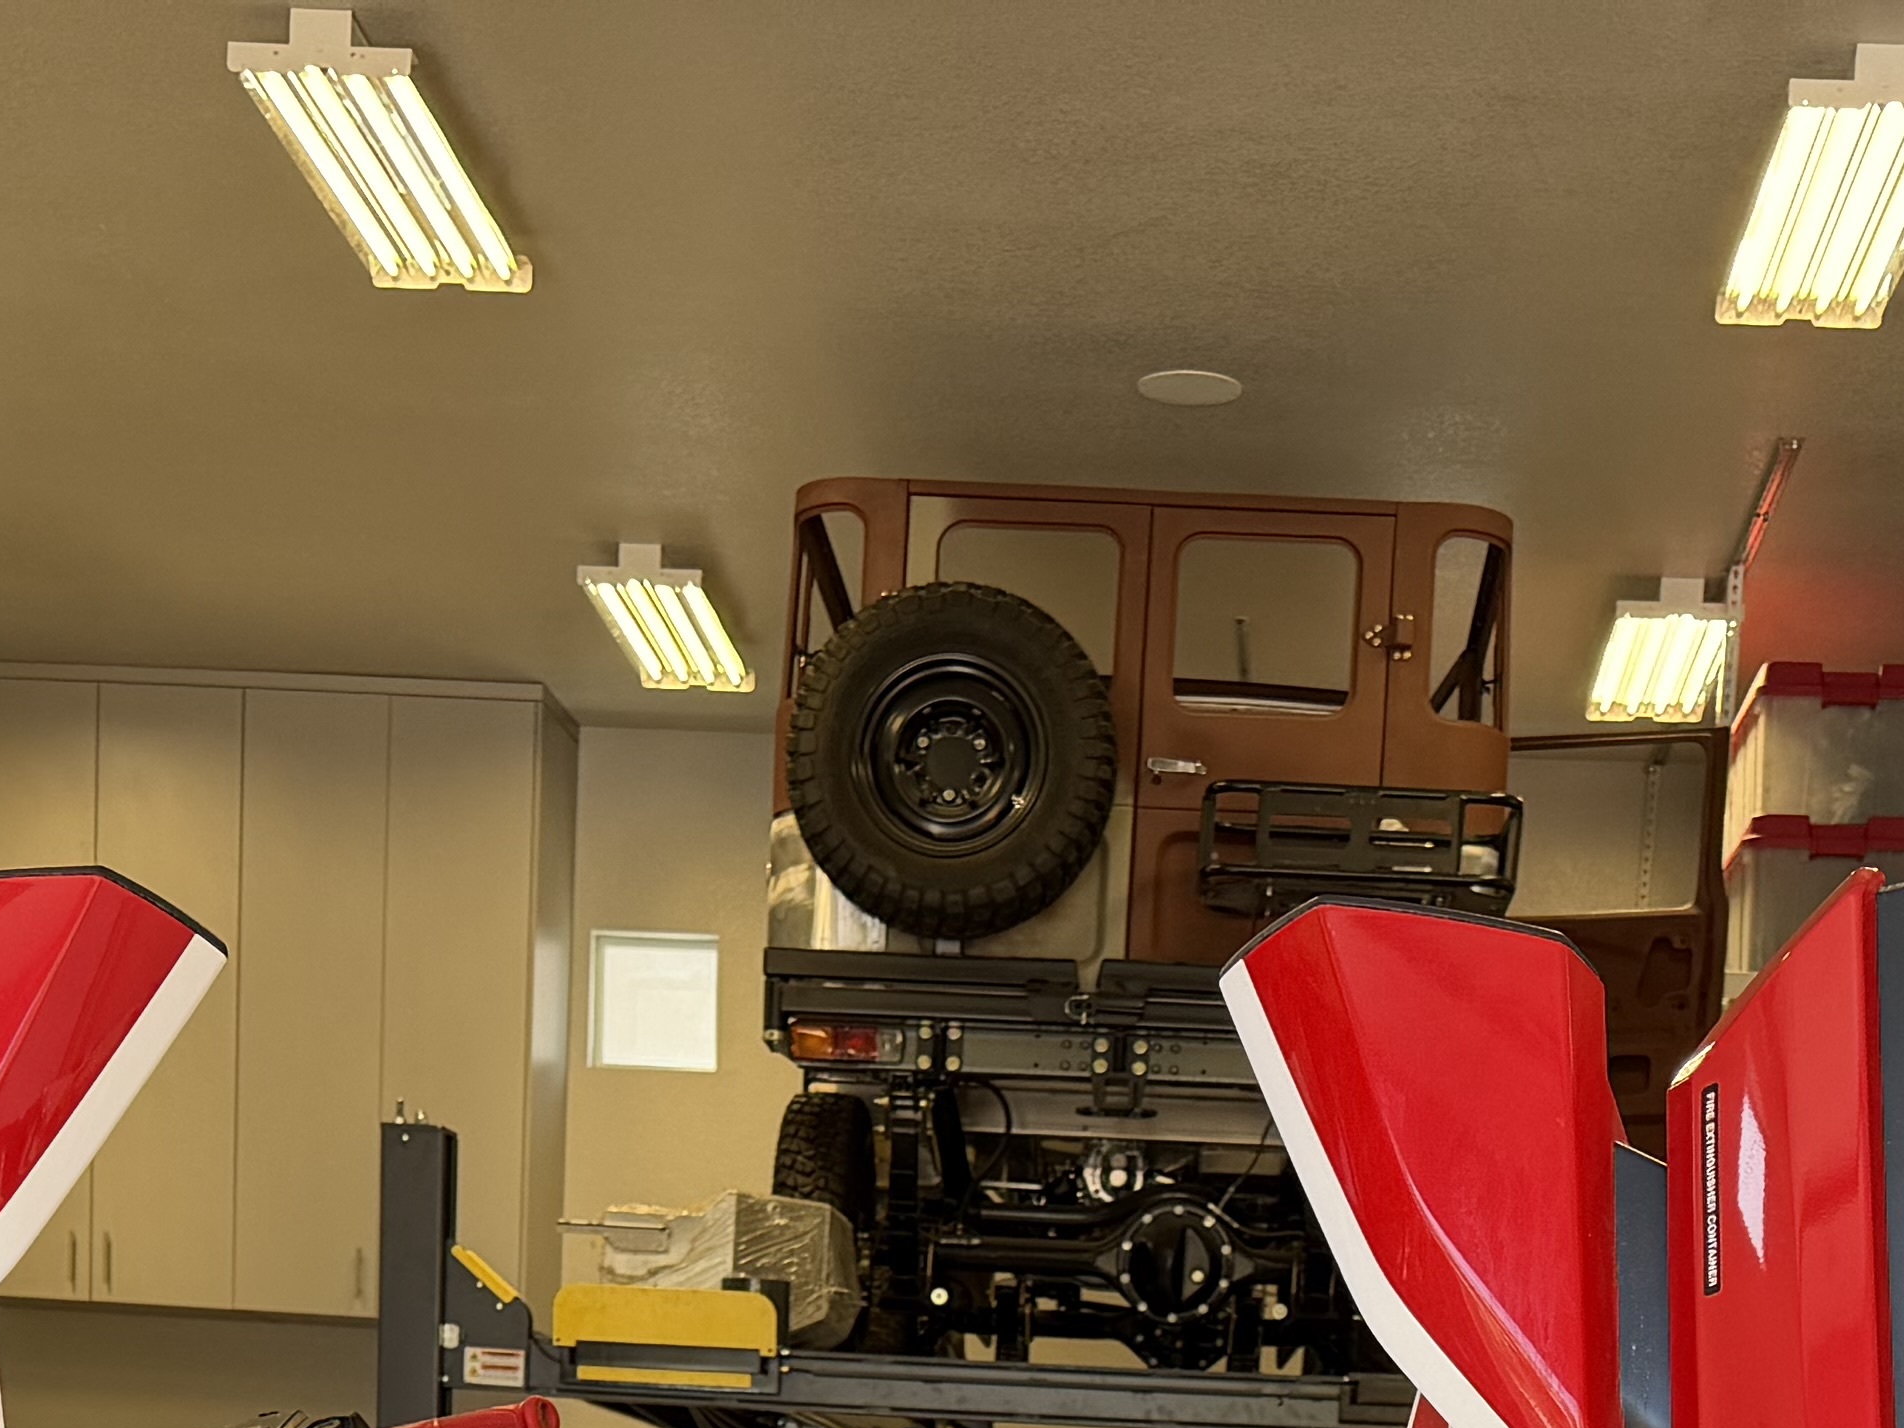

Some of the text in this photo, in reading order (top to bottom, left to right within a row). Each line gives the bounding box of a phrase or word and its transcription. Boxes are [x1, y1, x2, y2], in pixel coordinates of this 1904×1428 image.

[1706, 1091, 1719, 1288] FIRE EXTINGUISHER CONTAINER
